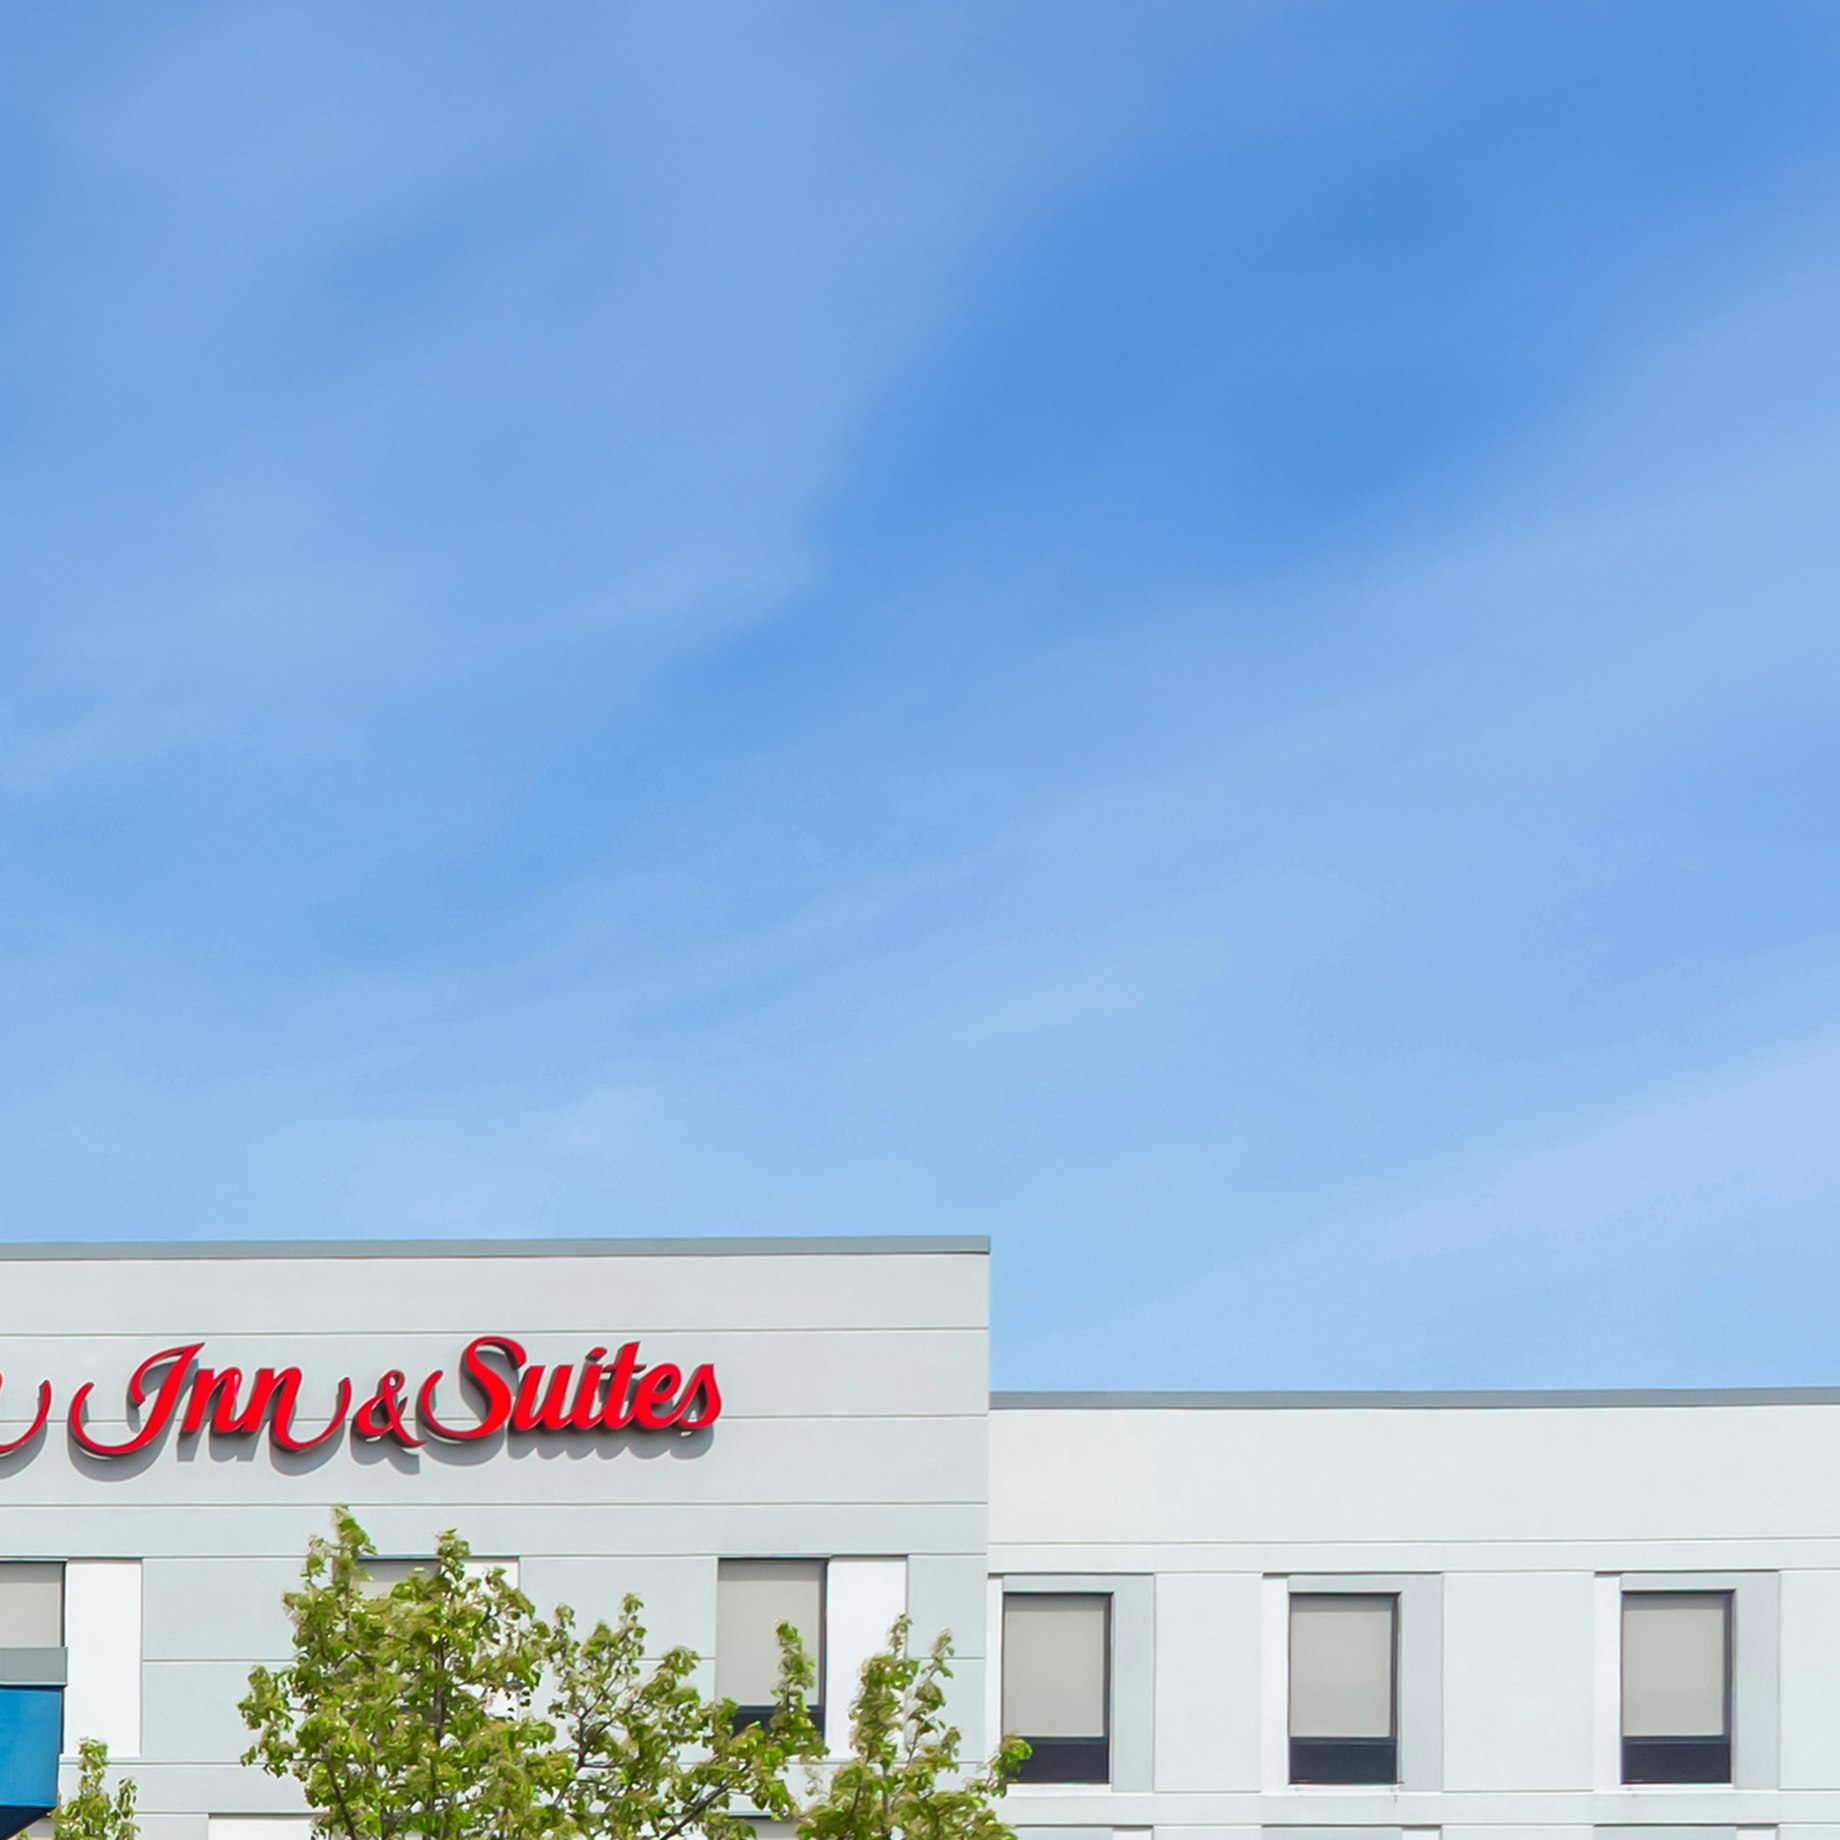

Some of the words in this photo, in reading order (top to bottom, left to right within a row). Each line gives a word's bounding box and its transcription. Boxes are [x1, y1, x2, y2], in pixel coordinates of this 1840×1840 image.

[70, 1342, 353, 1455] Inn
[354, 1369, 426, 1449] &
[419, 1335, 723, 1440] Suites
